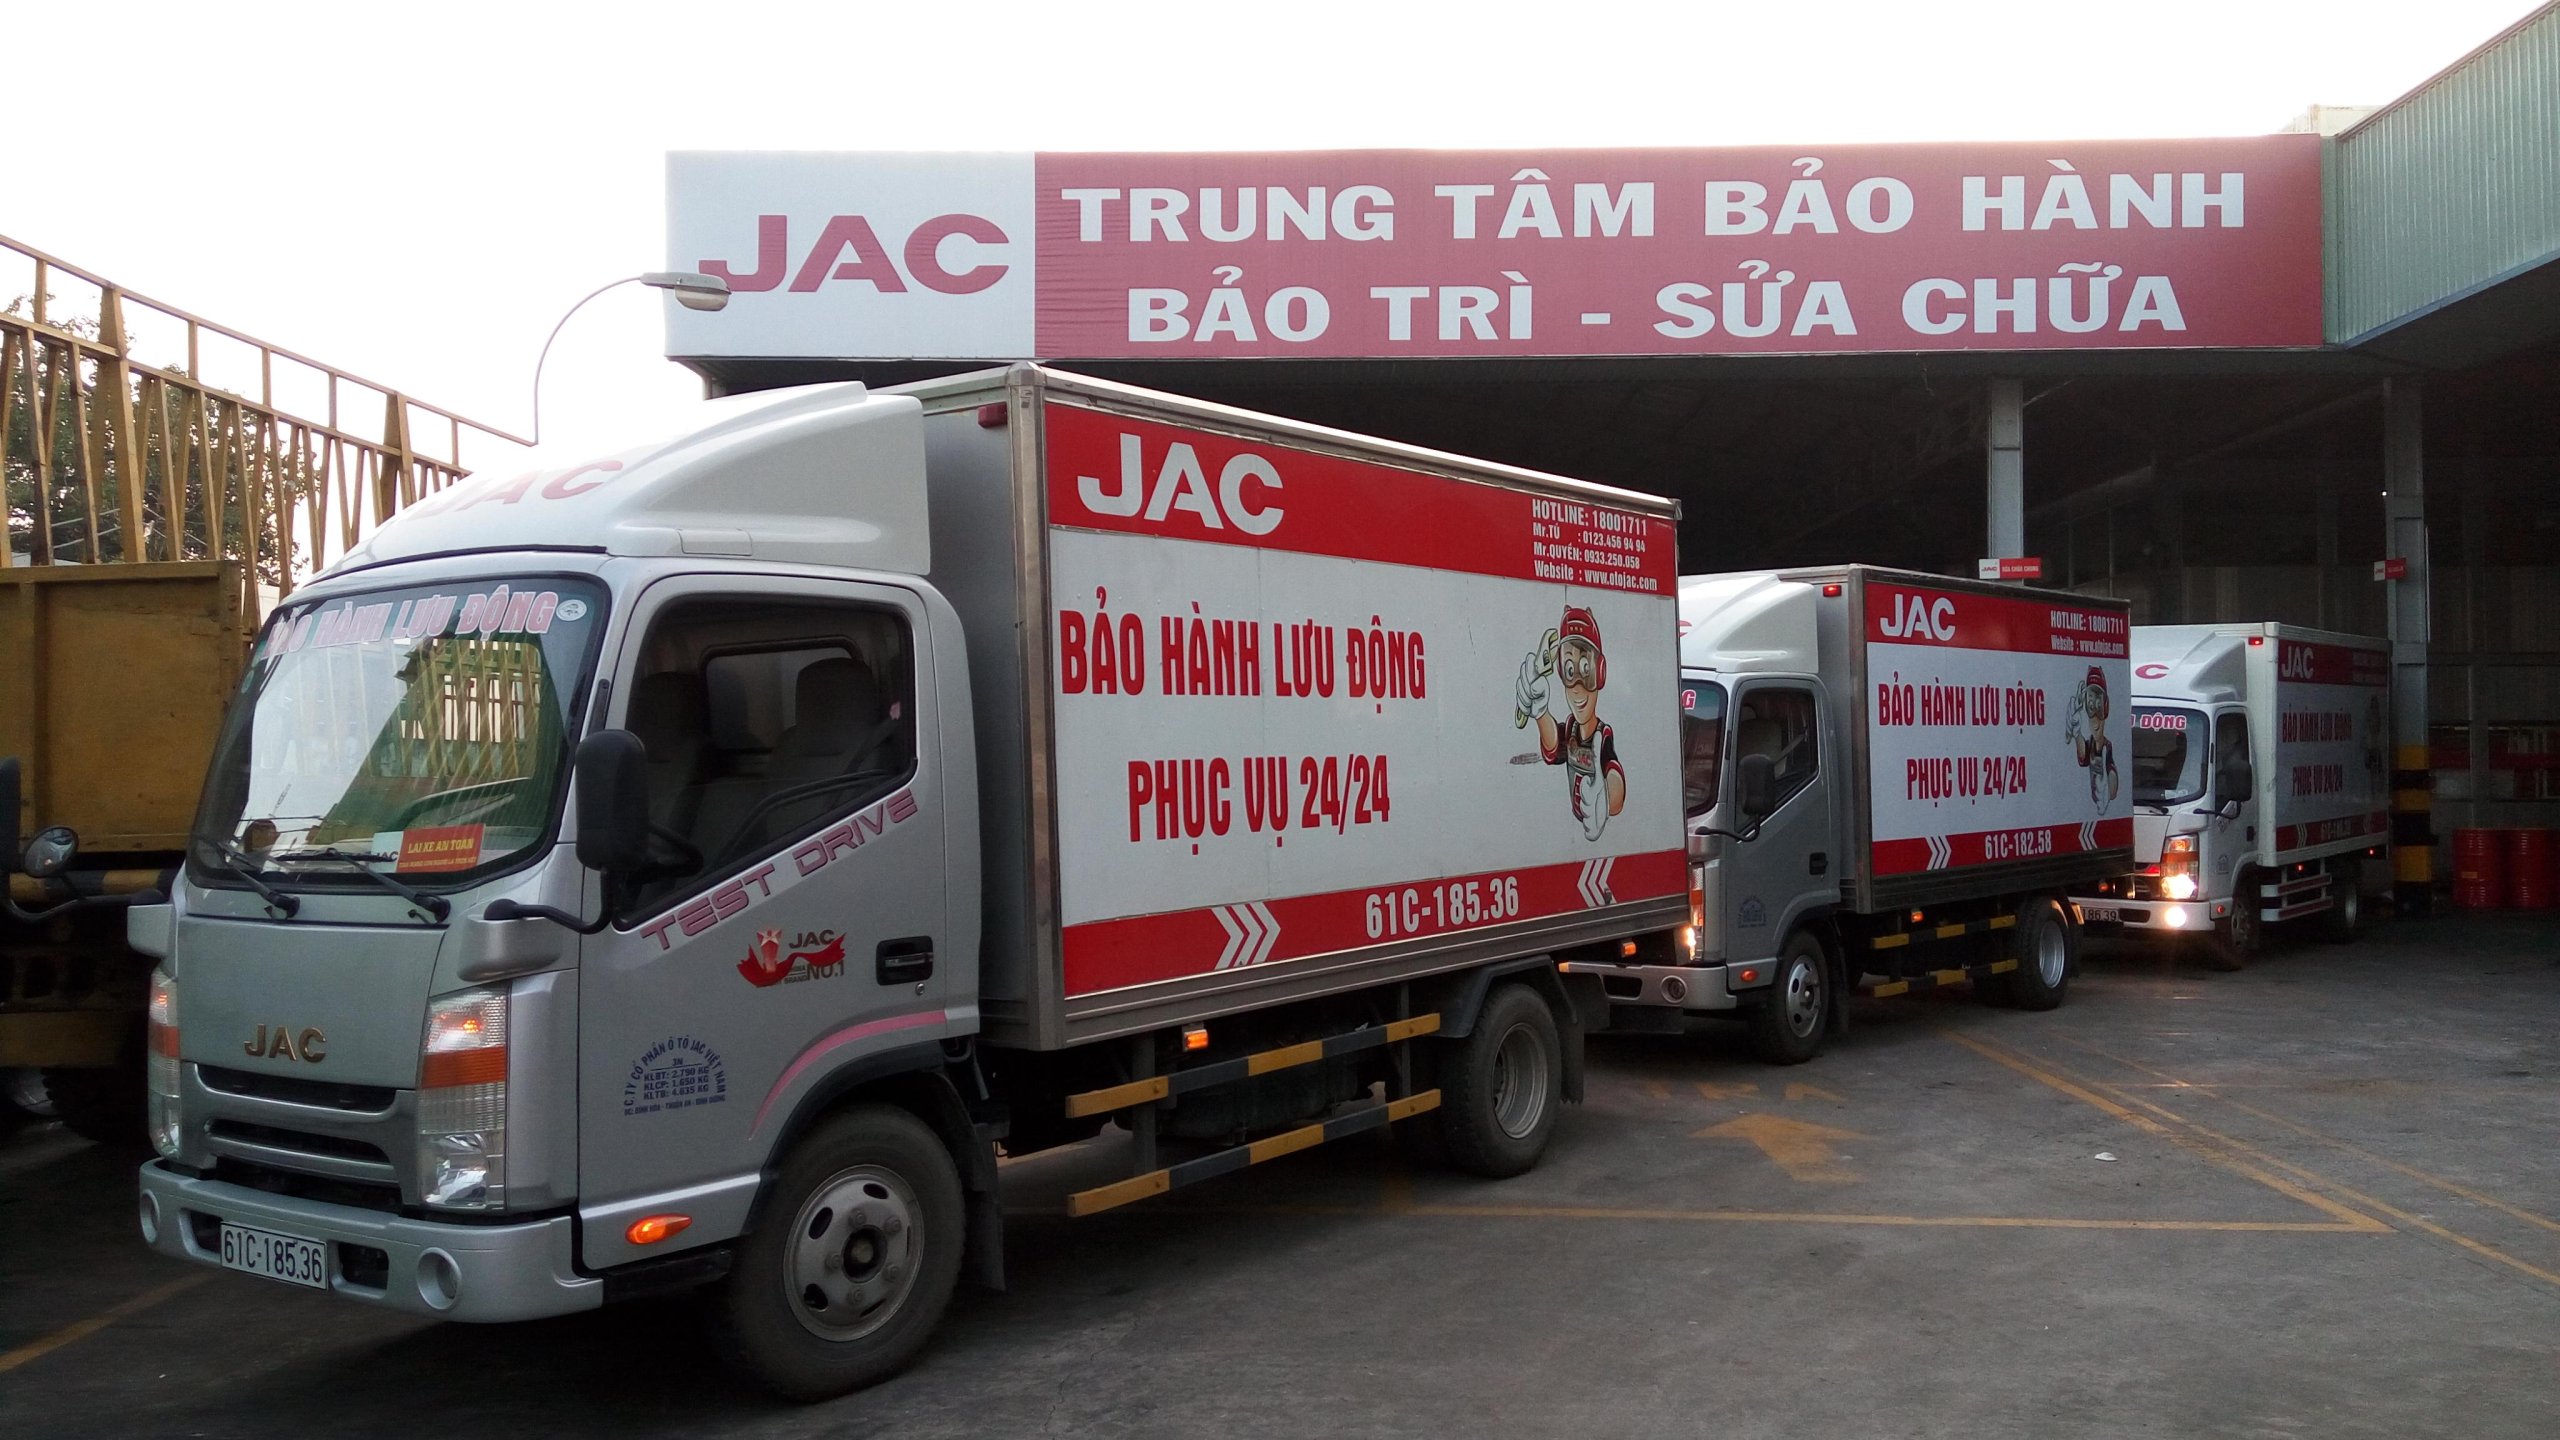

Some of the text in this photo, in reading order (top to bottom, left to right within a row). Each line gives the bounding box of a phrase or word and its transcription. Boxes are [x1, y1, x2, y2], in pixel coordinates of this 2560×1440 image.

[1062, 157, 2245, 243] TRUNG TÂM BẢO HÀNH
[698, 214, 1010, 294] JAC
[1128, 265, 1330, 342] BẢO
[1370, 270, 1533, 341] TRÌ
[1653, 260, 1858, 339] SỬA
[1901, 262, 2187, 334] CHỮA
[1077, 432, 1285, 536] JAC
[1532, 498, 1647, 537] HOTLINE: 18001711
[1583, 531, 1621, 549] 0123.456
[1584, 549, 1640, 570] 0933.250.058
[1534, 560, 1574, 580] Website
[1584, 569, 1658, 591] www.otojac.com
[311, 601, 393, 649] HÀNH
[390, 594, 458, 639] LƯU
[455, 584, 559, 641] ĐỘNG
[1879, 593, 1956, 641] JAC
[2050, 610, 2124, 634] HOTLINE: 18001711
[1059, 586, 1426, 714] BẢO HÀNH LƯU ĐỘNG
[2281, 645, 2314, 679] JAC
[1878, 671, 2045, 734] BẢO HÀNH LƯU ĐỘNG
[2139, 711, 2187, 732] ĐỘNG
[1906, 755, 2027, 808] PHỤC VỤ 24/24
[1129, 752, 1390, 855] PHỤC VỤ 24/24
[1984, 829, 2052, 860] 61C-182.58
[640, 788, 918, 951] TEST DRIVE
[1365, 876, 1519, 939] 61C-185.36
[789, 929, 835, 949] JAC
[243, 1023, 327, 1063] JAC
[690, 1040, 706, 1054] JAC
[697, 1066, 709, 1074] KG
[697, 1075, 709, 1083] KG
[697, 1084, 709, 1092] KG
[224, 1230, 322, 1282] 61C-185.36
